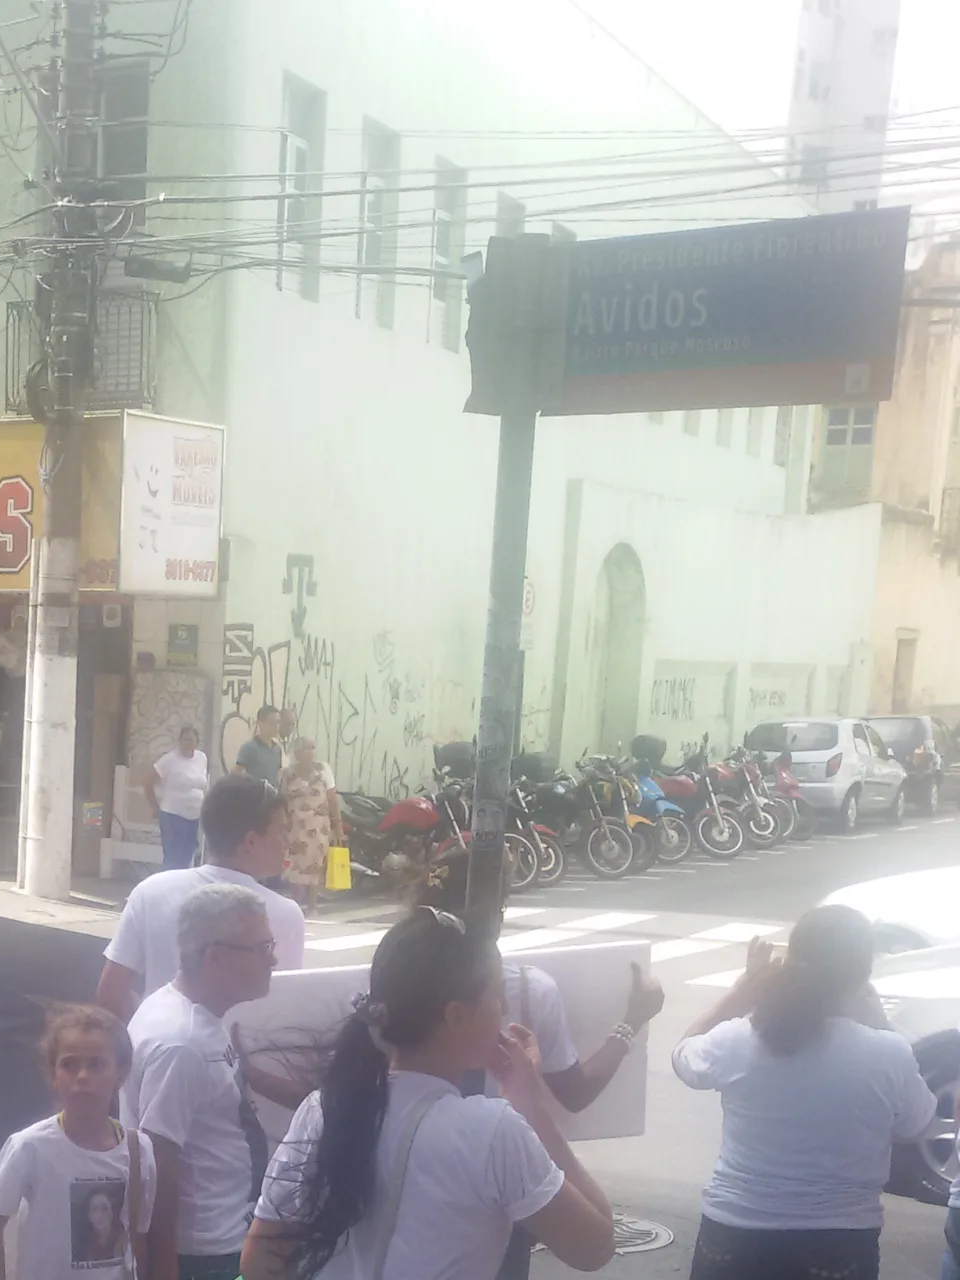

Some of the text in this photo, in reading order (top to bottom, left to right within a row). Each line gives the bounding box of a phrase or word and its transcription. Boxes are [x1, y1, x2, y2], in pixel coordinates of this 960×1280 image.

[617, 240, 745, 274] Presidente
[753, 224, 888, 262] Florentino
[573, 280, 709, 336] Avidos
[624, 338, 678, 362] Parque
